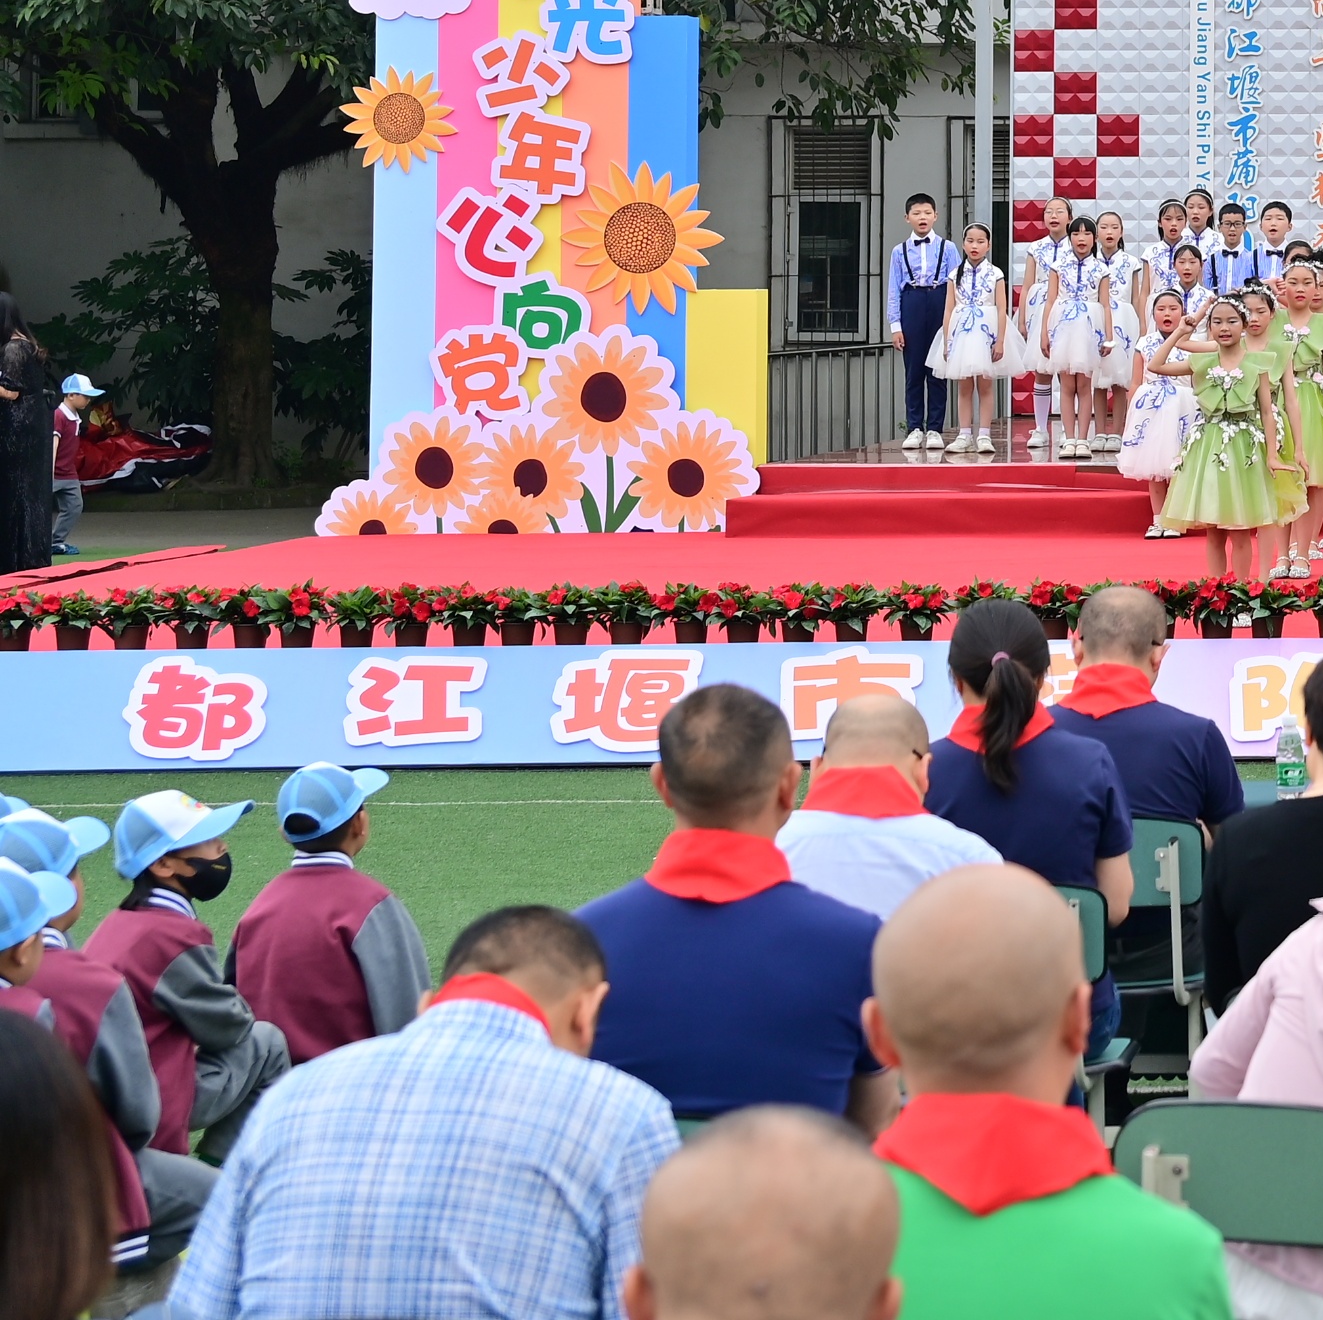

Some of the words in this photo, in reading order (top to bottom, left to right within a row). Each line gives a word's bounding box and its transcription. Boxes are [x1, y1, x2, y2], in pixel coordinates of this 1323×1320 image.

[1194, 17, 1212, 66] Jiang
[1195, 71, 1212, 105] Yan
[1195, 110, 1212, 139] Shi
[1195, 143, 1212, 166] Pu
[1195, 170, 1212, 191] Ya
